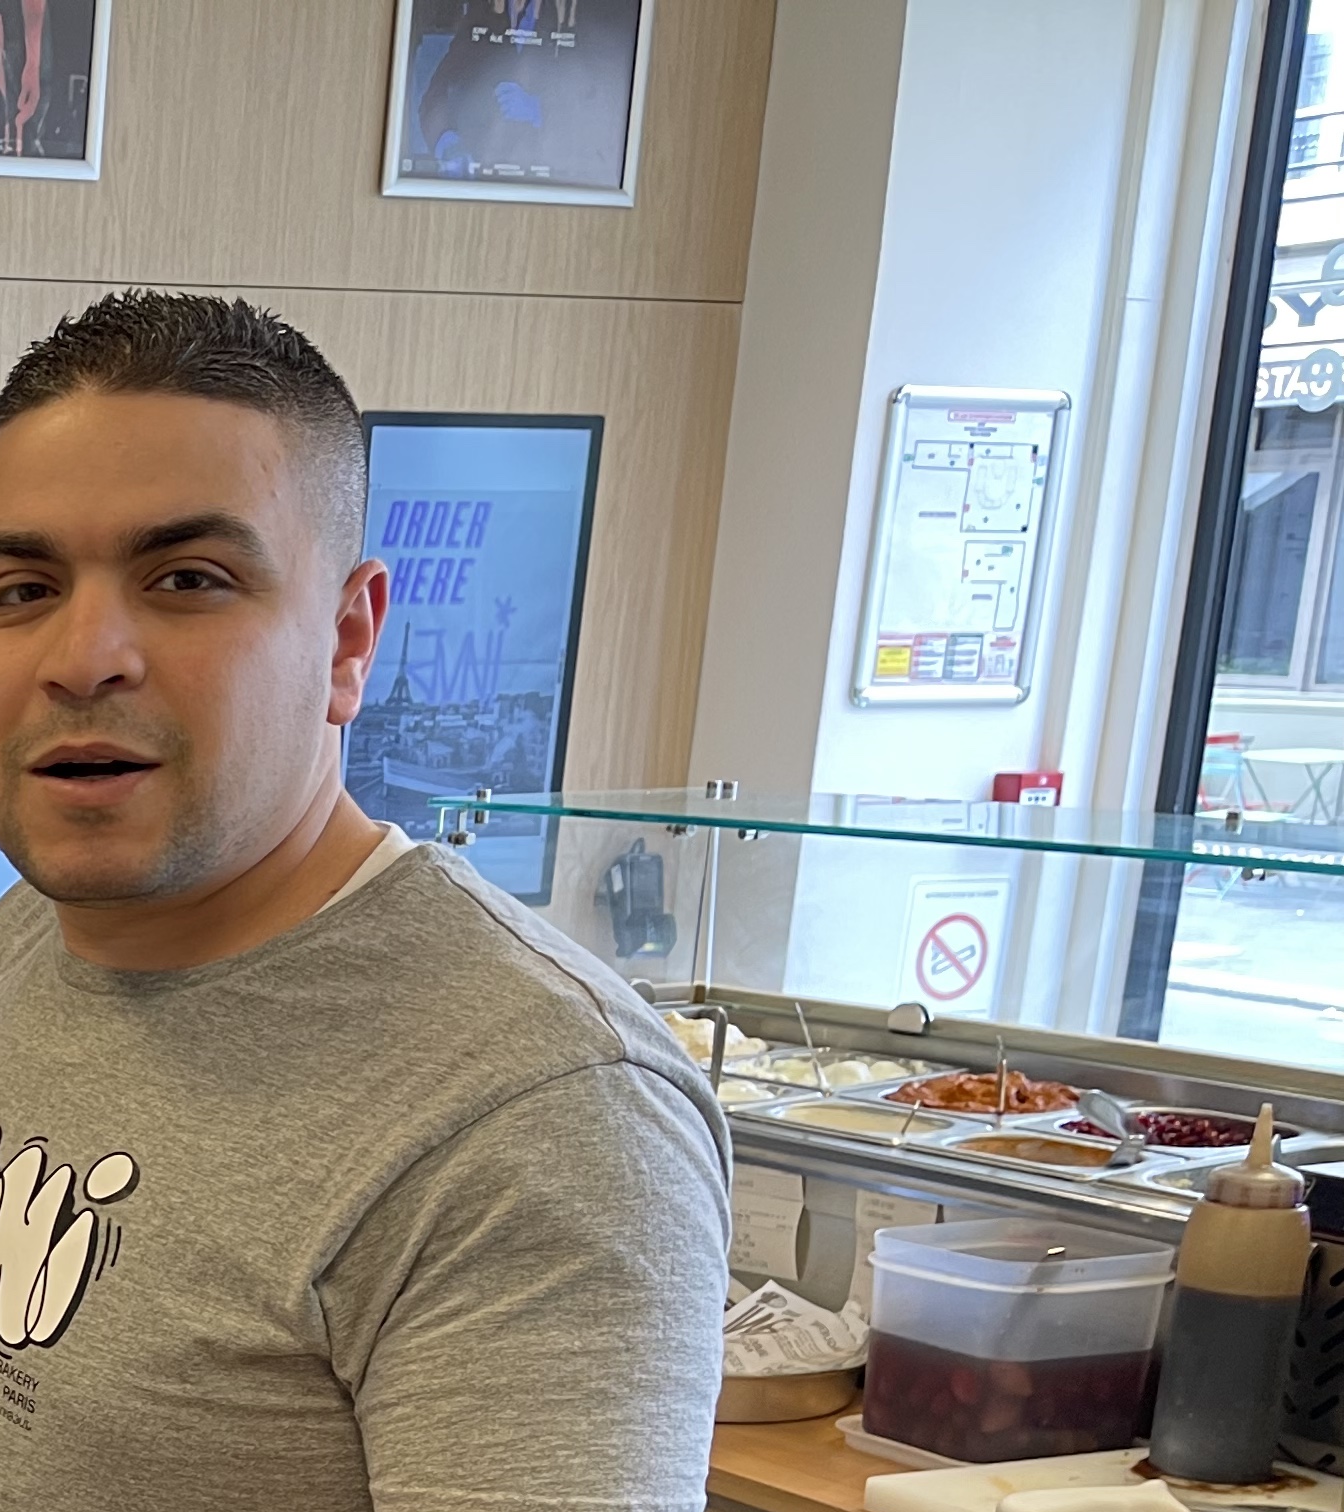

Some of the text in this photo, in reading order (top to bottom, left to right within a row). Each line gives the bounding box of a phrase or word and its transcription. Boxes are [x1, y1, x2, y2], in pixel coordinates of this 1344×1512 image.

[381, 500, 494, 549] ORDER
[389, 557, 476, 605] HERE
[2, 1385, 37, 1414] PARIS
